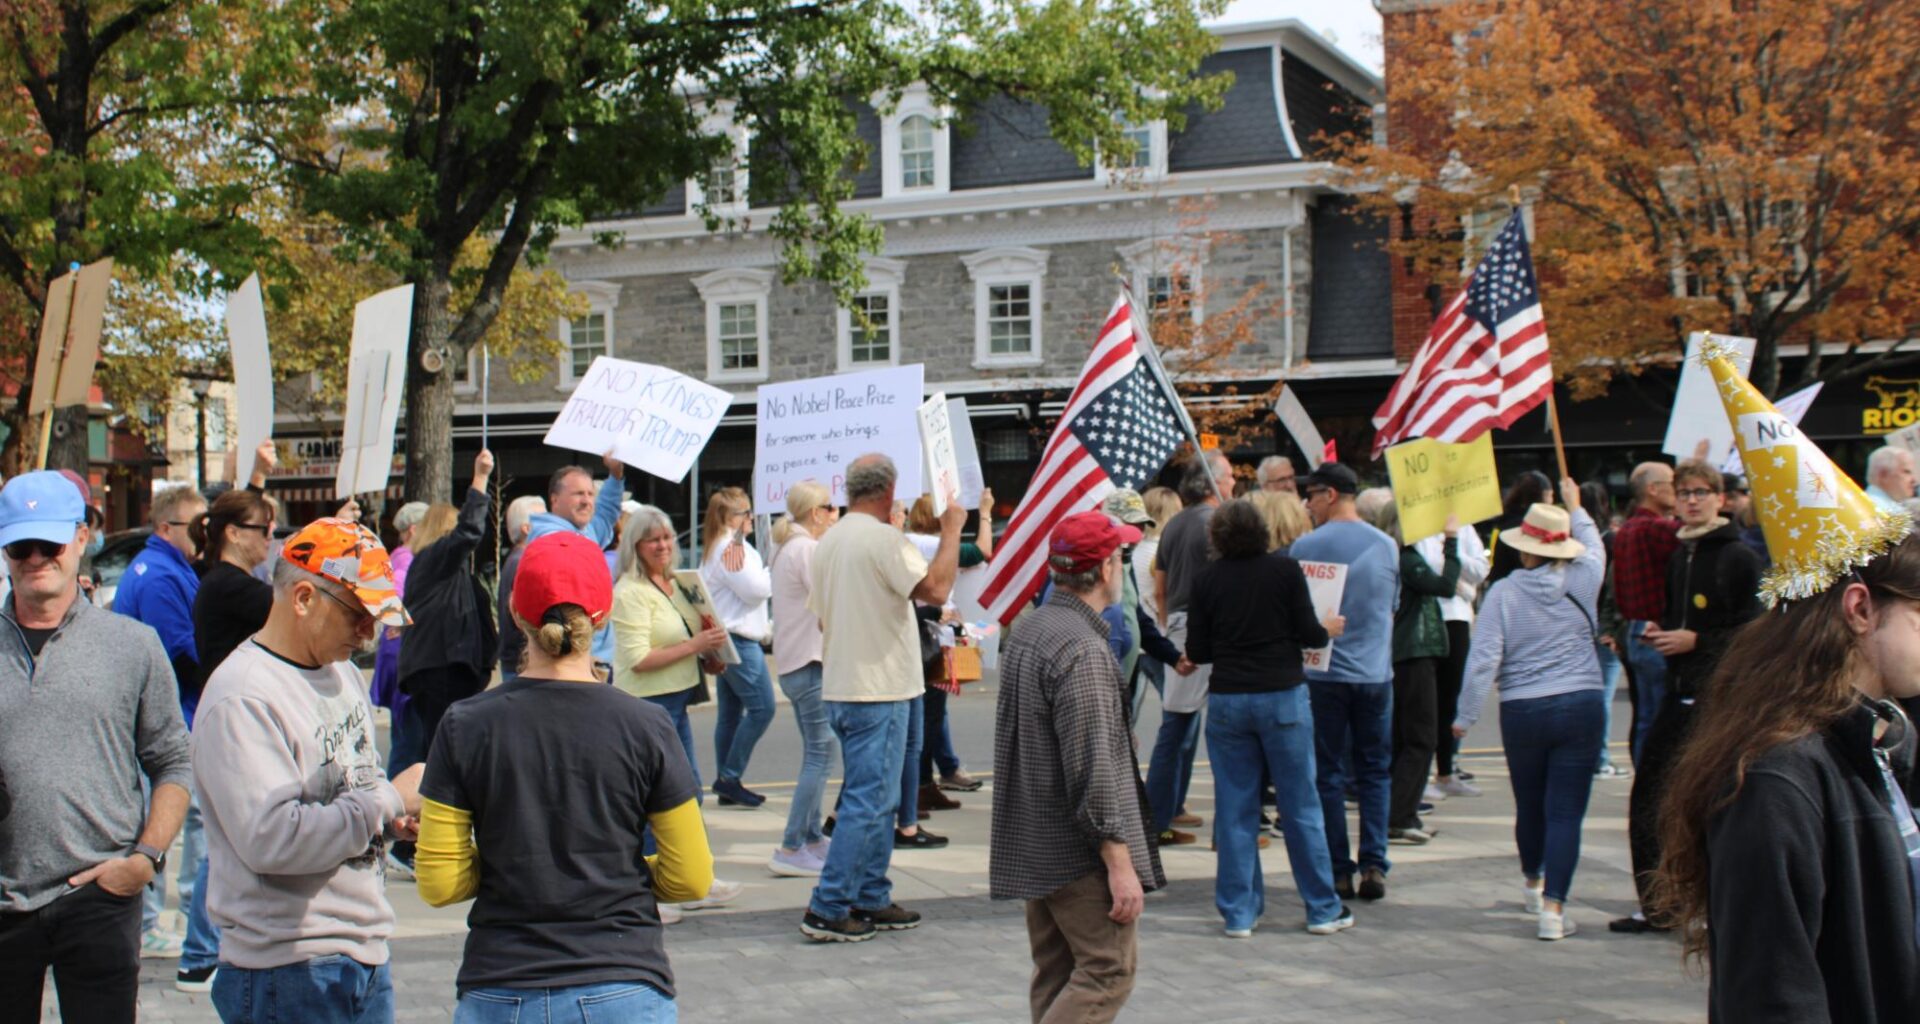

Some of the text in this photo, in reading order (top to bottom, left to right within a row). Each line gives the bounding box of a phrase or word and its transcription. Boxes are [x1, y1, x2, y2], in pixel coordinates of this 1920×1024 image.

[593, 367, 718, 420] NO KINGS
[766, 384, 896, 420] No Nobel Peace Prize
[566, 398, 702, 457] TRAITOR TRUMP
[1863, 407, 1920, 428] RIO
[765, 423, 879, 448] for someone who brings
[1757, 420, 1794, 442] NO
[766, 451, 839, 474] no peace to
[1404, 452, 1429, 477] NO
[1302, 563, 1337, 580] INGS
